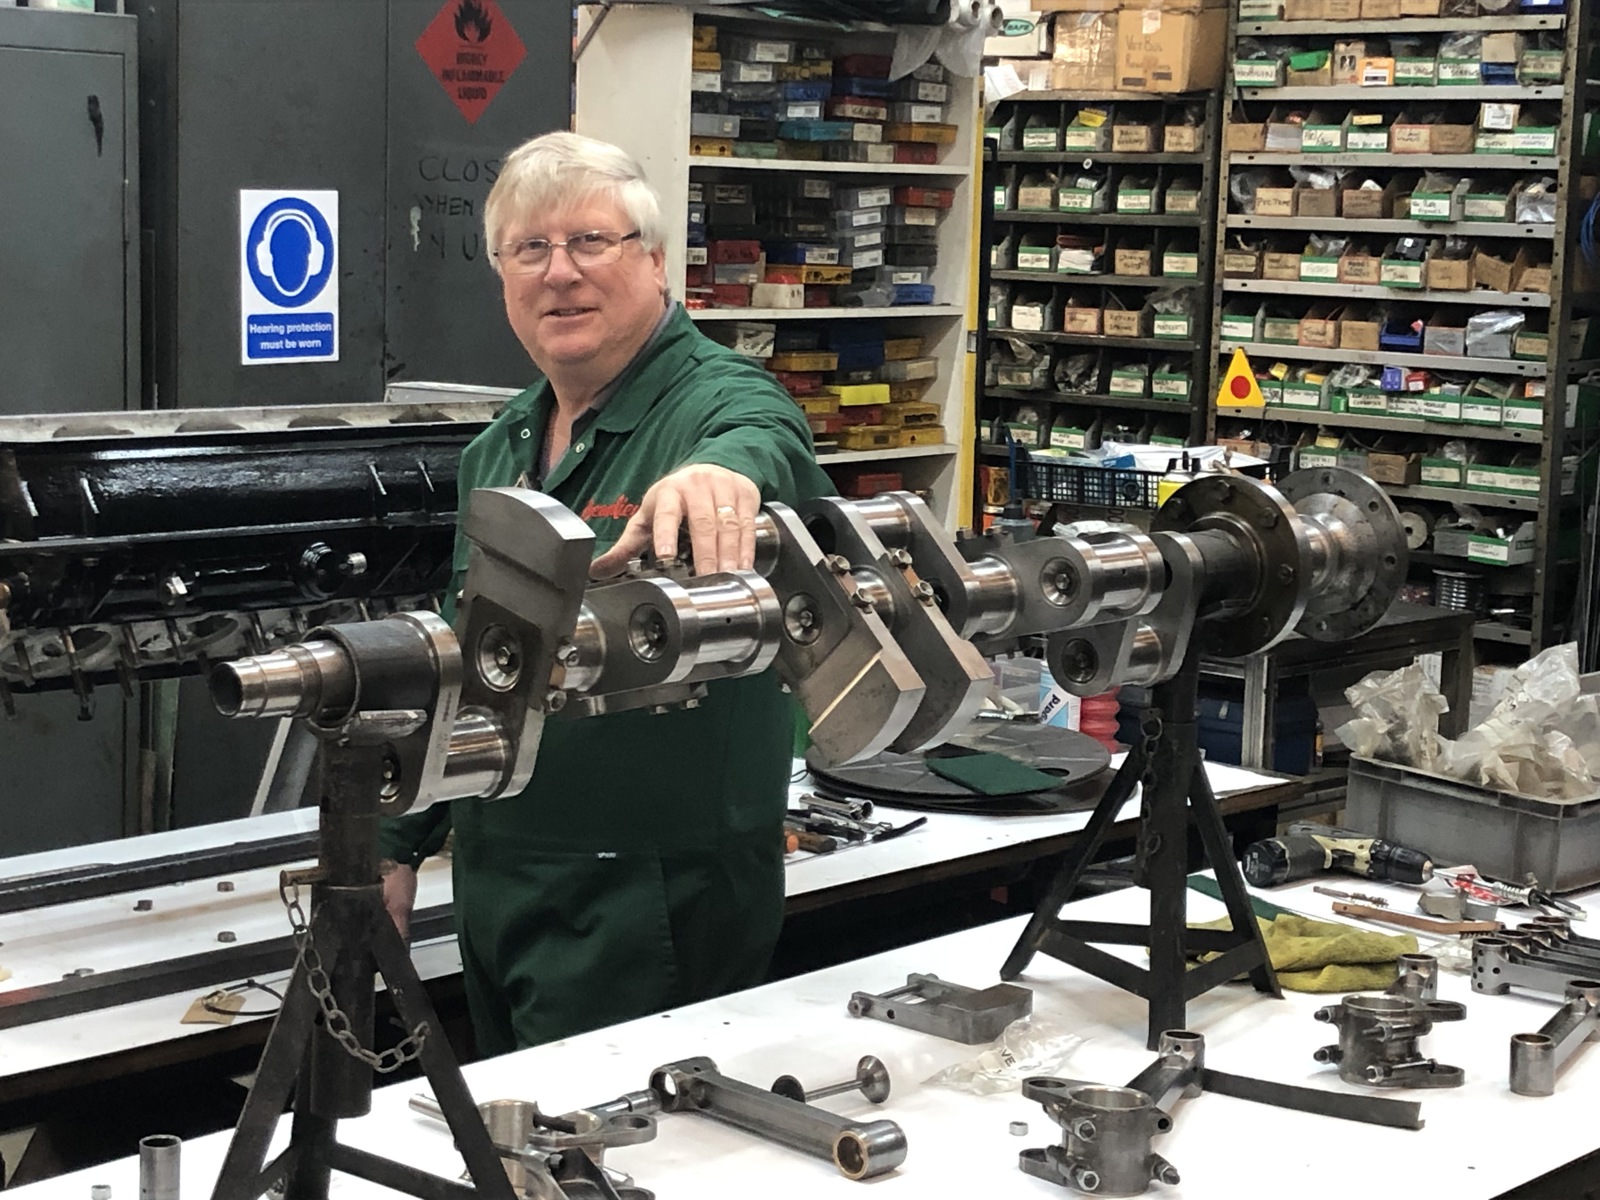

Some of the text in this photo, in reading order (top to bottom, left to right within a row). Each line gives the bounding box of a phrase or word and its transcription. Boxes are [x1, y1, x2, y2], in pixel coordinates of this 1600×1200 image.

[249, 321, 332, 335] Hearing protection
[260, 338, 322, 350] must be worn
[1505, 409, 1519, 419] 6V
